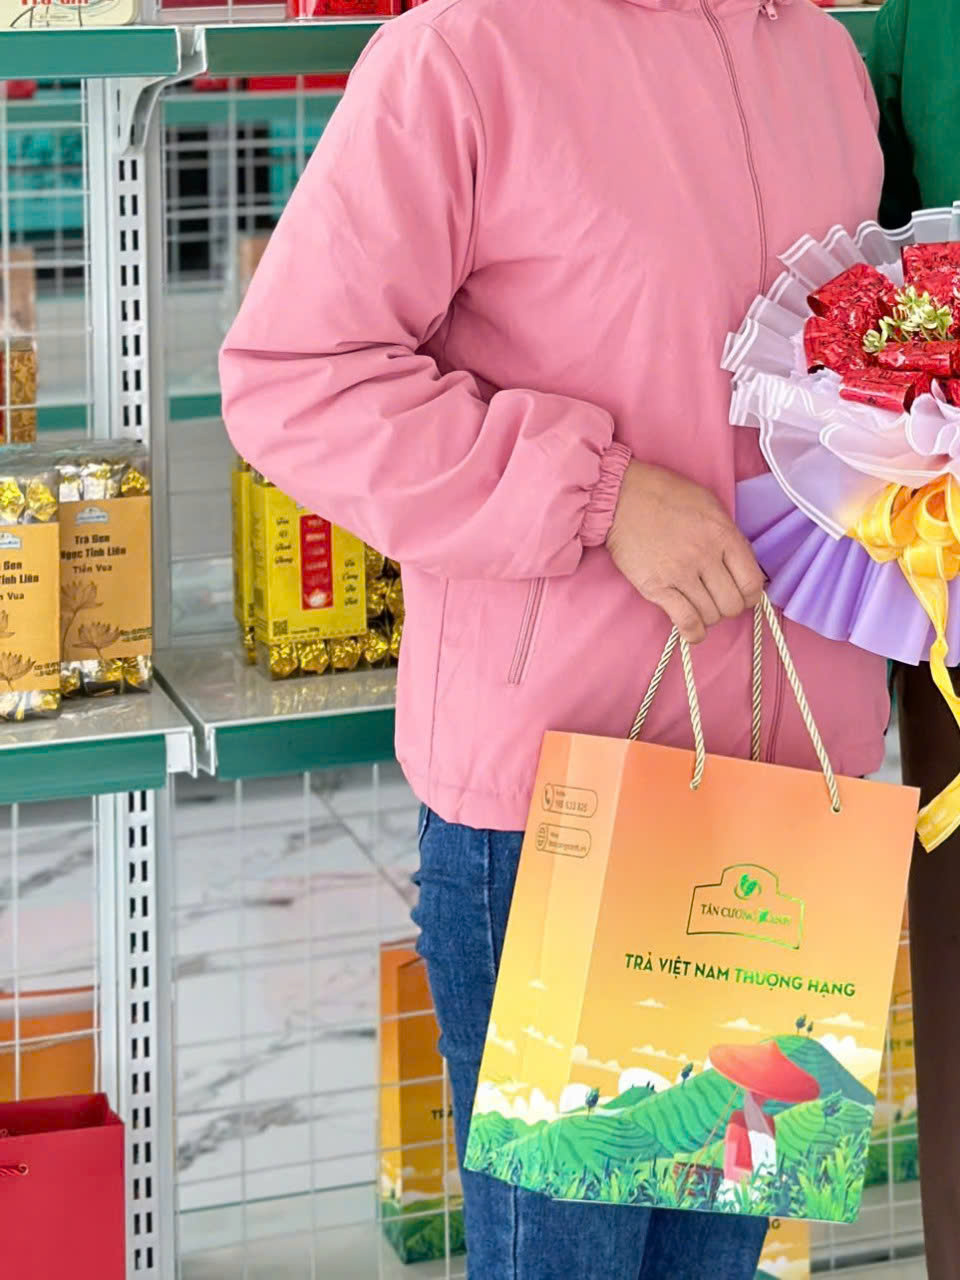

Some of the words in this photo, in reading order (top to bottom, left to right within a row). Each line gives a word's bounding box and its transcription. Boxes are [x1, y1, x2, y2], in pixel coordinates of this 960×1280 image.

[659, 955, 692, 979] VIỆT
[694, 963, 730, 981] NAM
[807, 979, 856, 998] HẠNG
